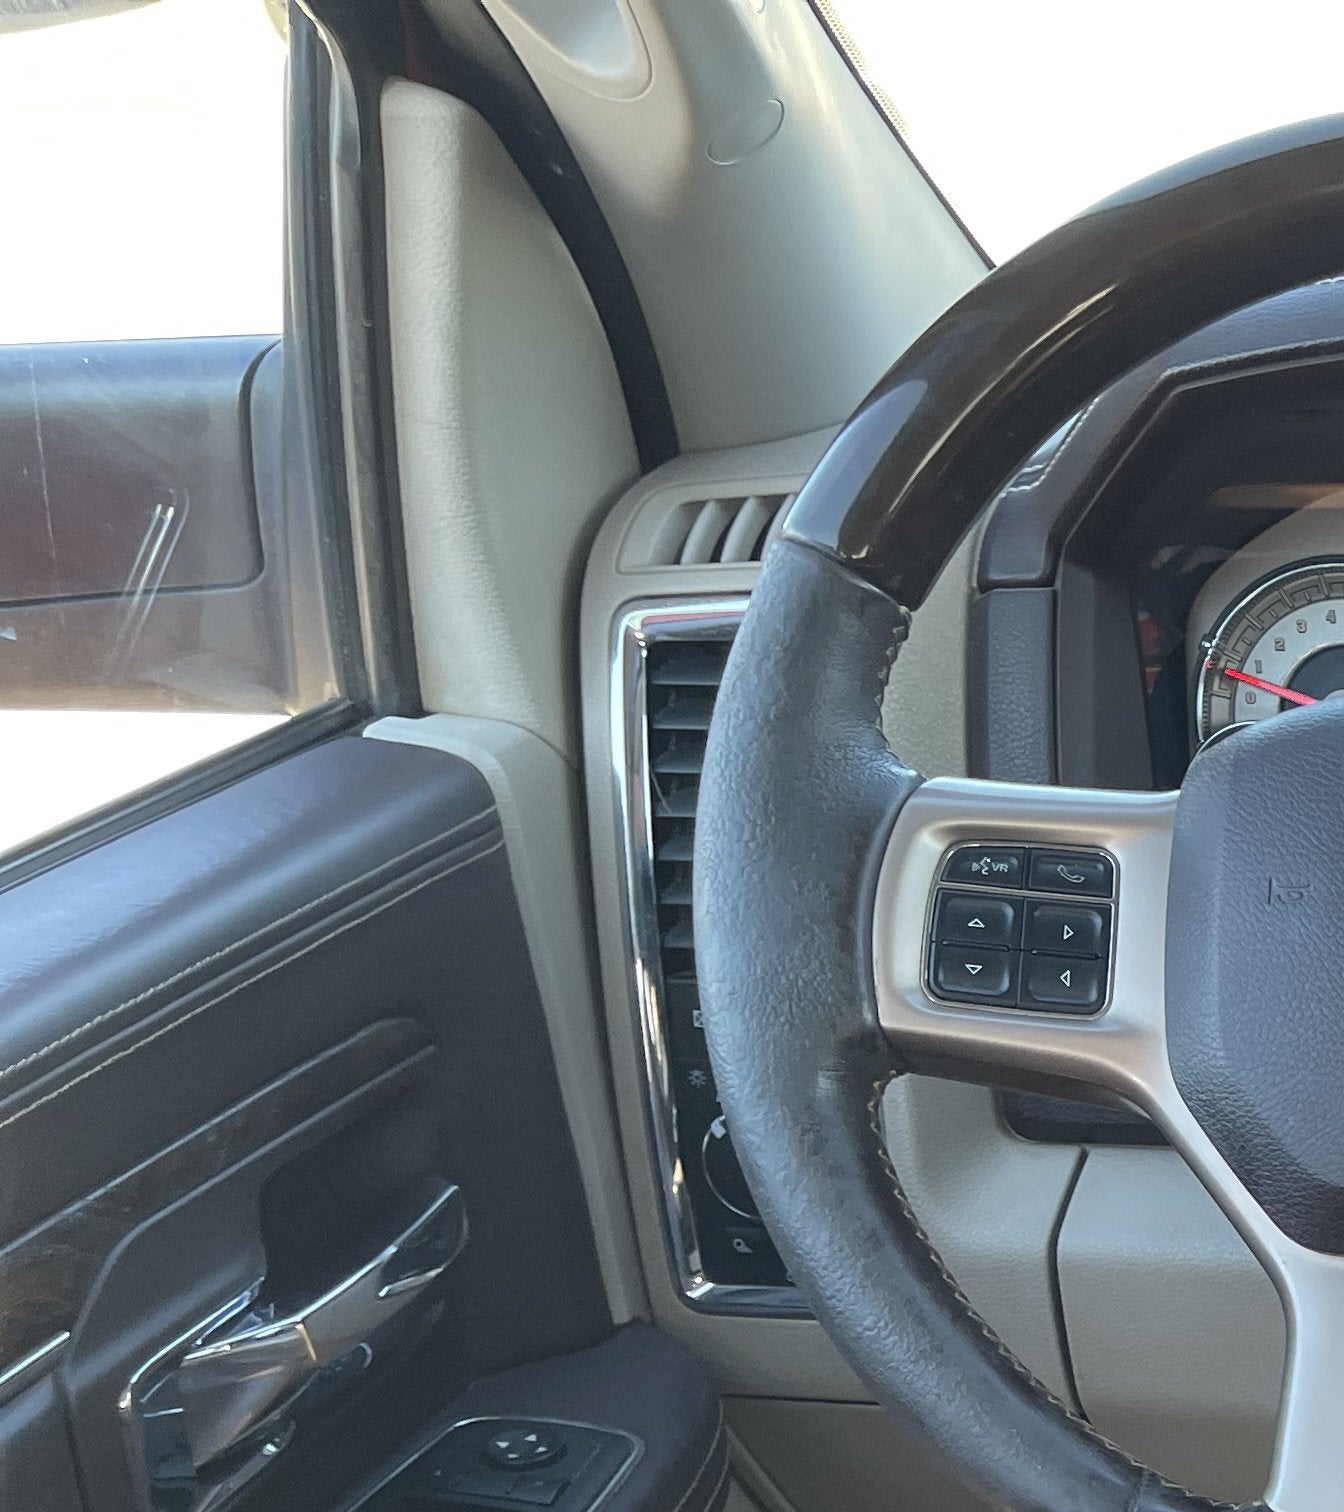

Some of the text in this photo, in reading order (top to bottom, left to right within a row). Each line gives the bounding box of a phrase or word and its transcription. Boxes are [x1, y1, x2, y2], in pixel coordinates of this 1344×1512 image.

[1325, 610, 1337, 624] 4
[1296, 619, 1307, 633] 3
[1274, 638, 1286, 651] 2
[1254, 660, 1263, 674] 1
[1244, 691, 1257, 705] 0
